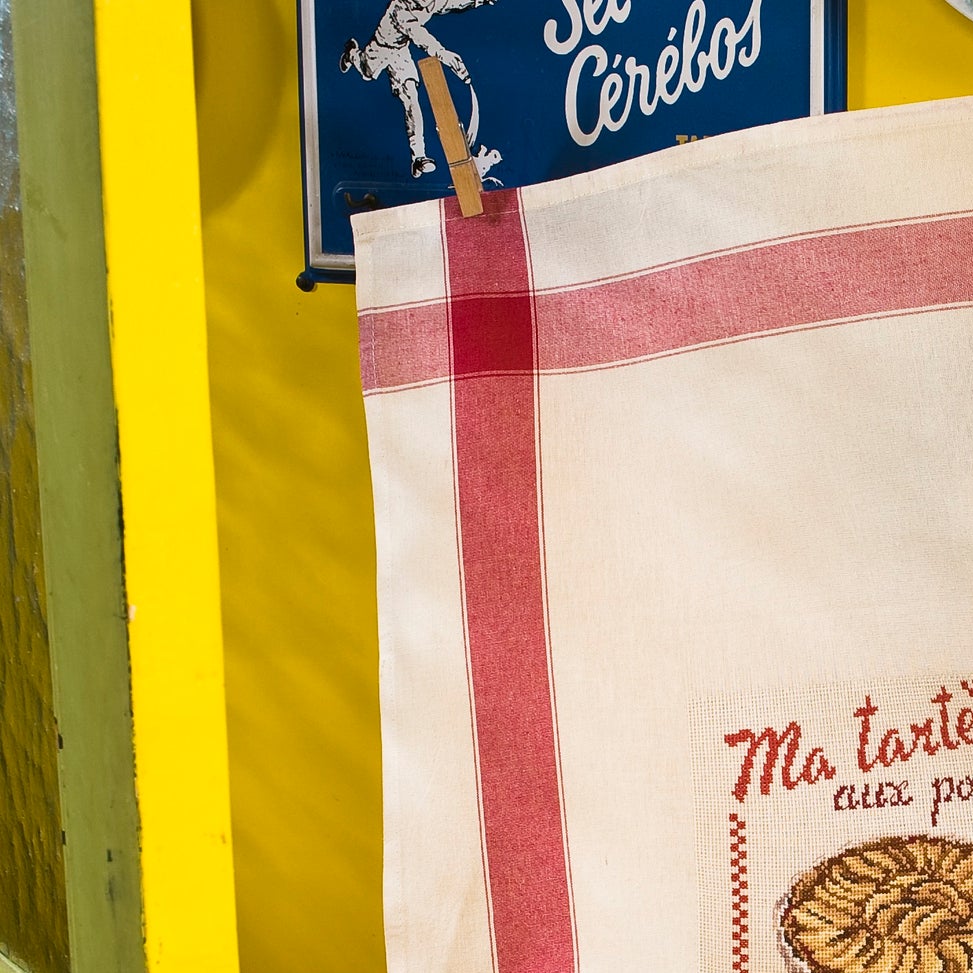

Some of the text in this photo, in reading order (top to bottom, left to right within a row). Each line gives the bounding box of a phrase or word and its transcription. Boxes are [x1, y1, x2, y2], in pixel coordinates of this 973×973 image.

[544, 0, 631, 55] Se
[565, 0, 762, 147] Cérébos
[724, 721, 836, 803] Ma
[833, 779, 914, 811] aux
